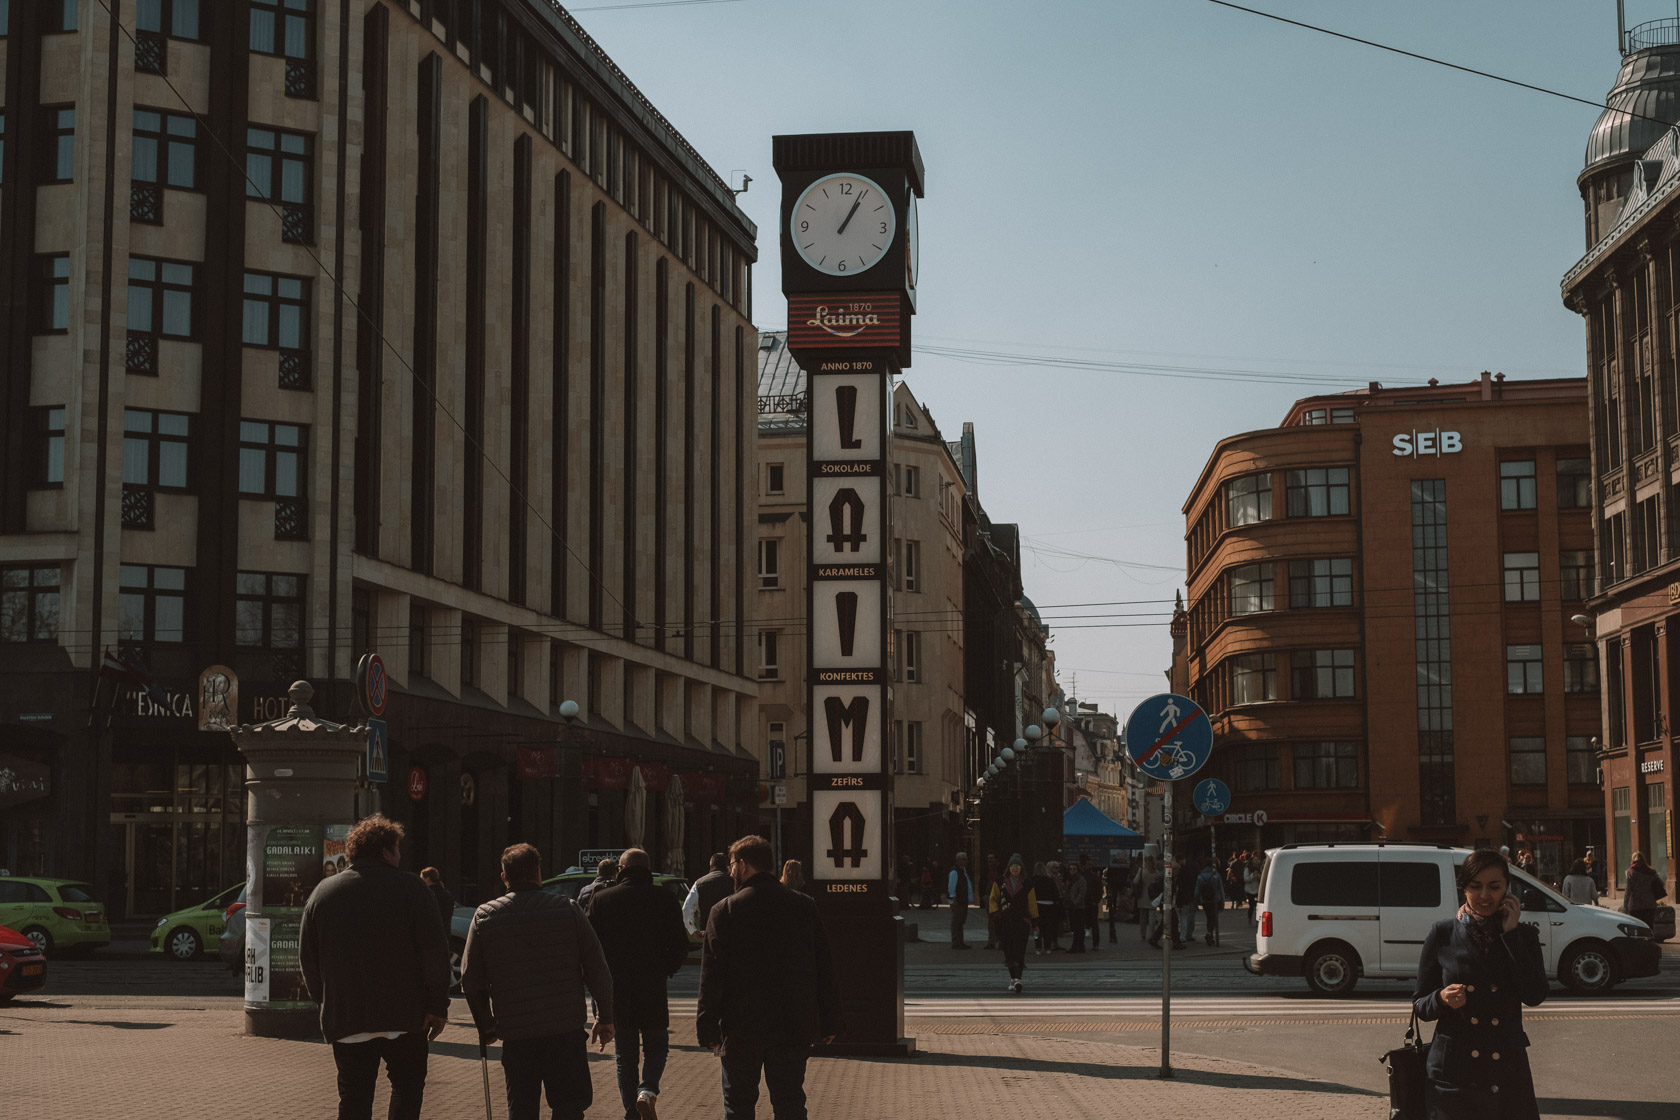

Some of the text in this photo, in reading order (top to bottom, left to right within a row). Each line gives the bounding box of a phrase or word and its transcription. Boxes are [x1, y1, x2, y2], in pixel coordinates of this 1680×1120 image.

[839, 182, 852, 195] 12
[800, 221, 809, 233] 9
[880, 222, 887, 234] 3
[838, 260, 846, 272] 6
[849, 302, 872, 312] 1870
[806, 305, 880, 328] Laima
[820, 362, 873, 371] ANNO 1870
[820, 463, 872, 474] ŠOKOLĀDE
[818, 568, 875, 577] KARAMELES
[819, 672, 874, 682] KONFEKTES
[831, 776, 864, 787] ZEFĪRS
[1224, 814, 1252, 824] CIRCLE
[266, 846, 316, 855] GADALAIKI
[826, 884, 868, 893] LEDENES
